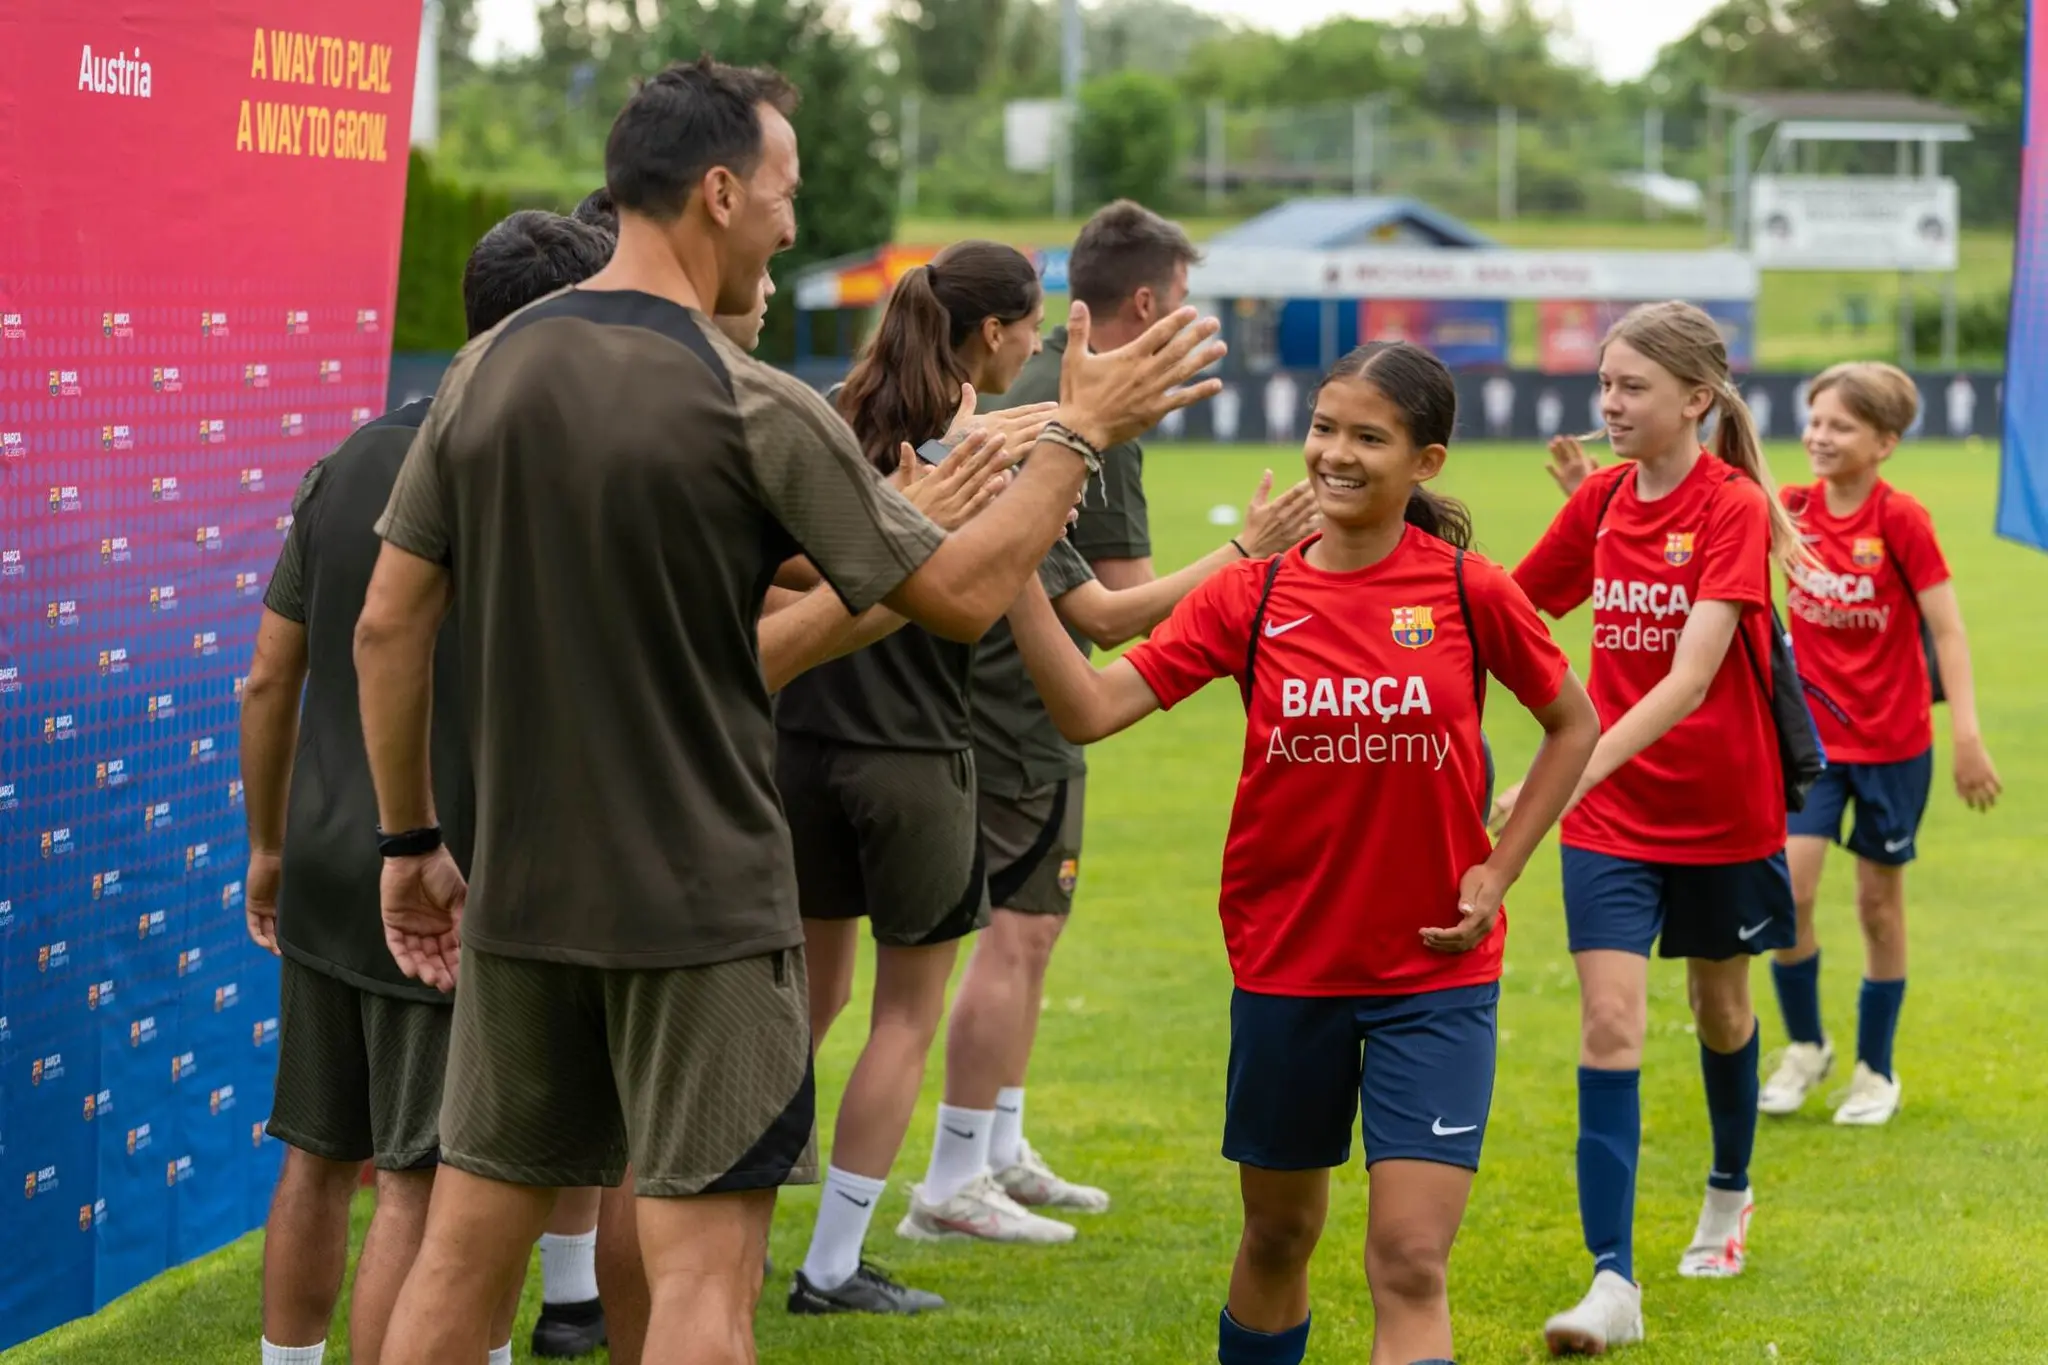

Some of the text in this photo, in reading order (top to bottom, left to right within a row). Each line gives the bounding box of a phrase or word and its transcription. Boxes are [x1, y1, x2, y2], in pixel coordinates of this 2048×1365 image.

[79, 44, 151, 98] Austria
[251, 27, 267, 80] A
[271, 30, 318, 84] WAY
[320, 36, 343, 88] TO
[236, 99, 253, 152] A
[257, 101, 305, 155] WAY
[307, 106, 330, 158] TO
[1593, 577, 1691, 621] BARÇA
[1594, 617, 1683, 652] cadem
[1282, 675, 1432, 723] BARÇA
[1265, 722, 1450, 771] Academy
